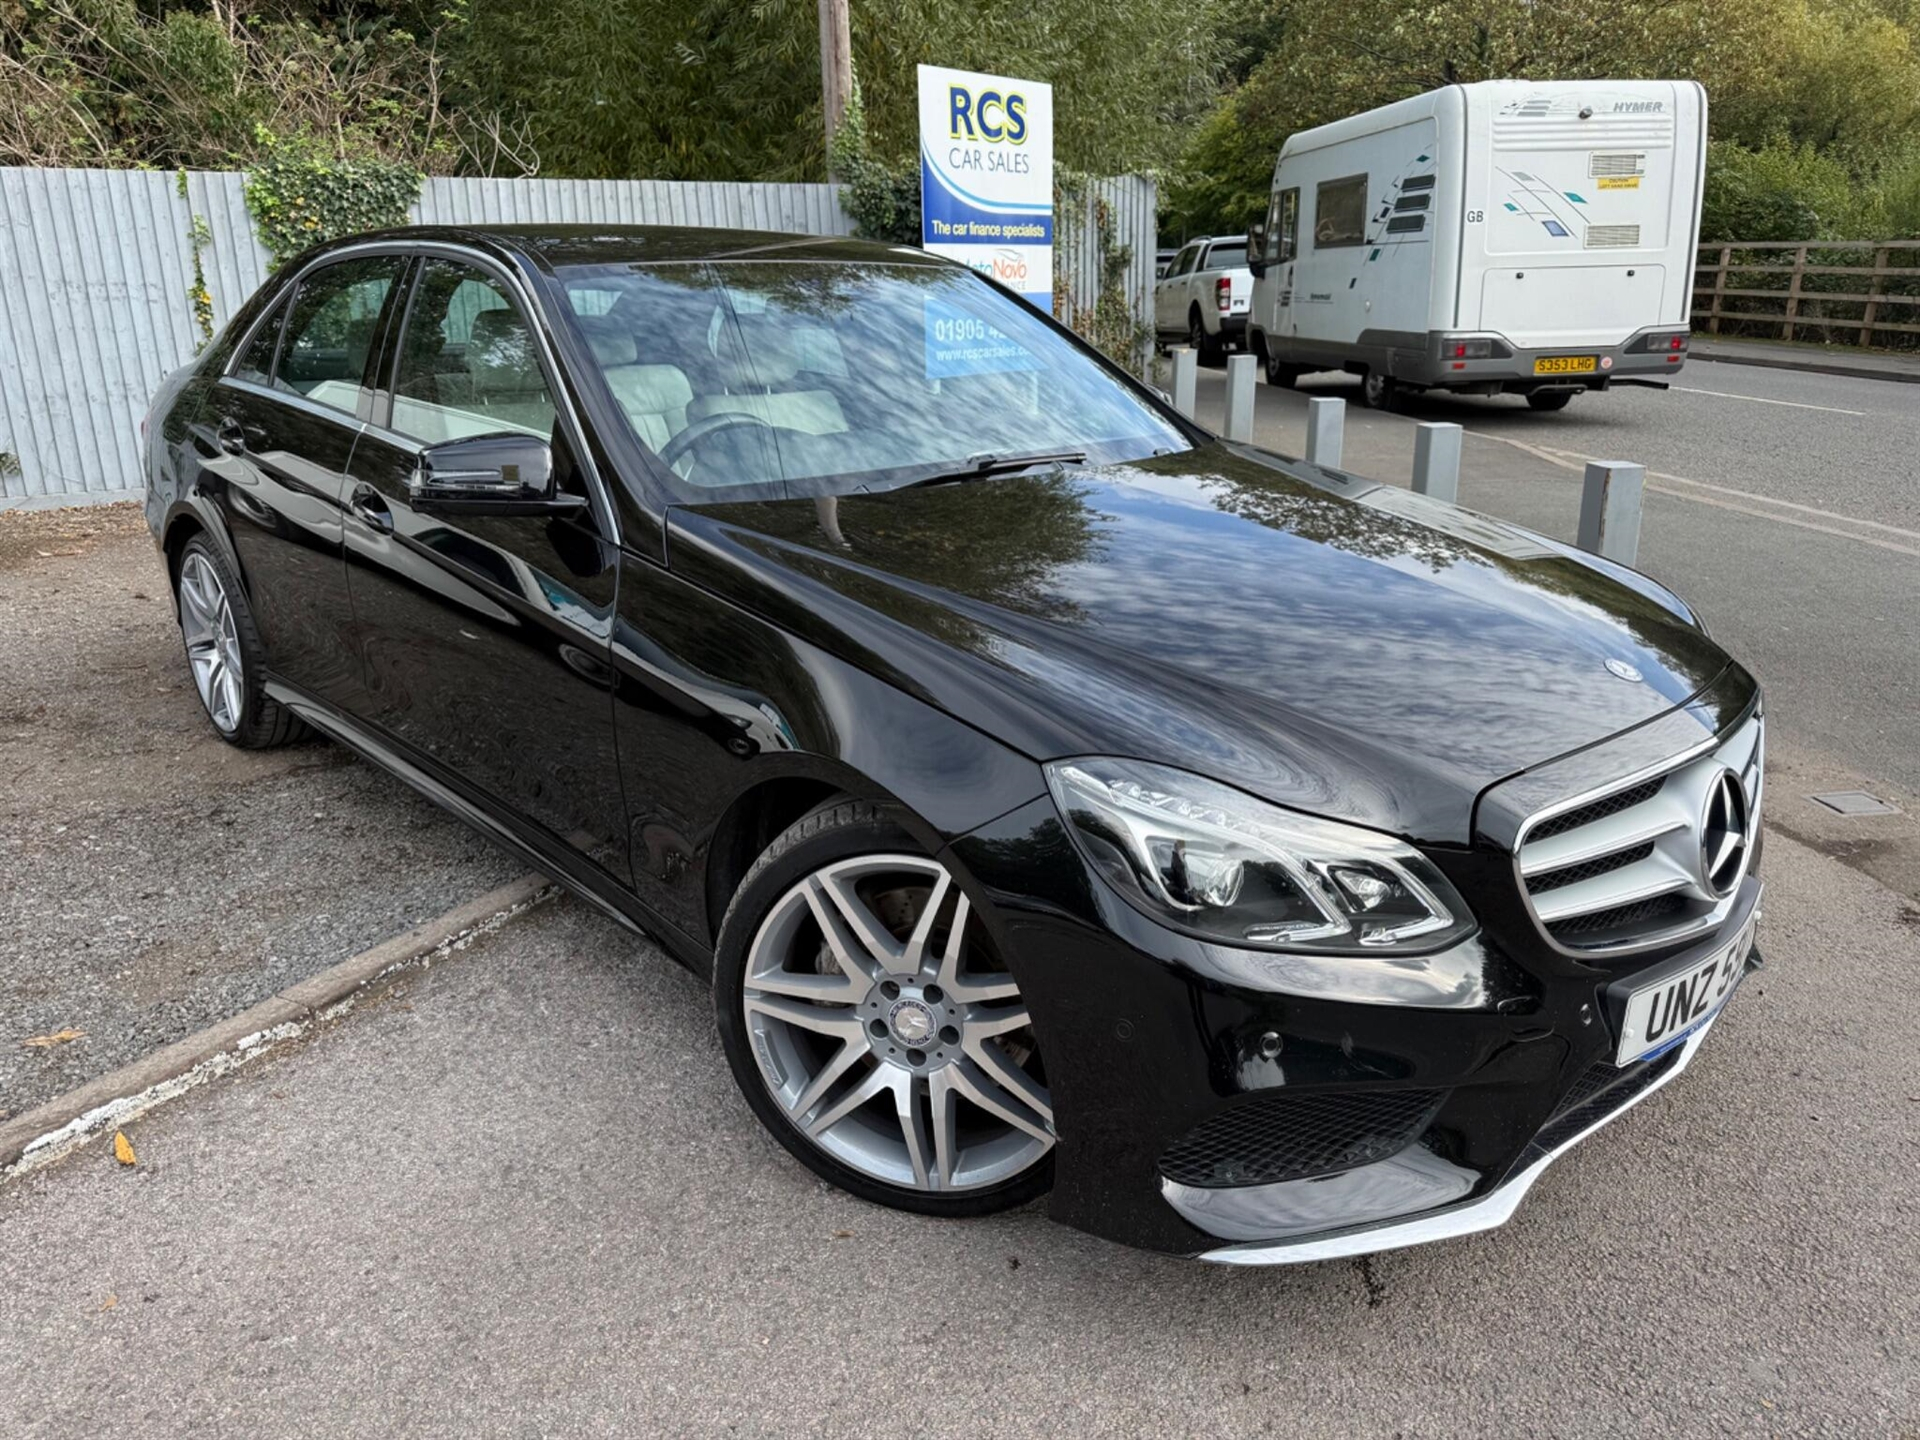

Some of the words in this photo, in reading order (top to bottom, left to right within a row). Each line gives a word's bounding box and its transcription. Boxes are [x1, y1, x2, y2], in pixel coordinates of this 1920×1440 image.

[948, 84, 1027, 144] RCS
[1613, 102, 1663, 113] HYMER
[949, 147, 983, 171] CAR
[988, 150, 1029, 174] SALES
[1467, 211, 1484, 223] GB
[932, 219, 951, 236] The
[953, 223, 968, 236] car
[969, 221, 1001, 237] finance
[1002, 222, 1046, 239] specialists
[936, 319, 985, 341] 01905
[1538, 358, 1568, 372] S353
[1570, 357, 1591, 371] LHG
[1646, 960, 1718, 1043] UNZ
